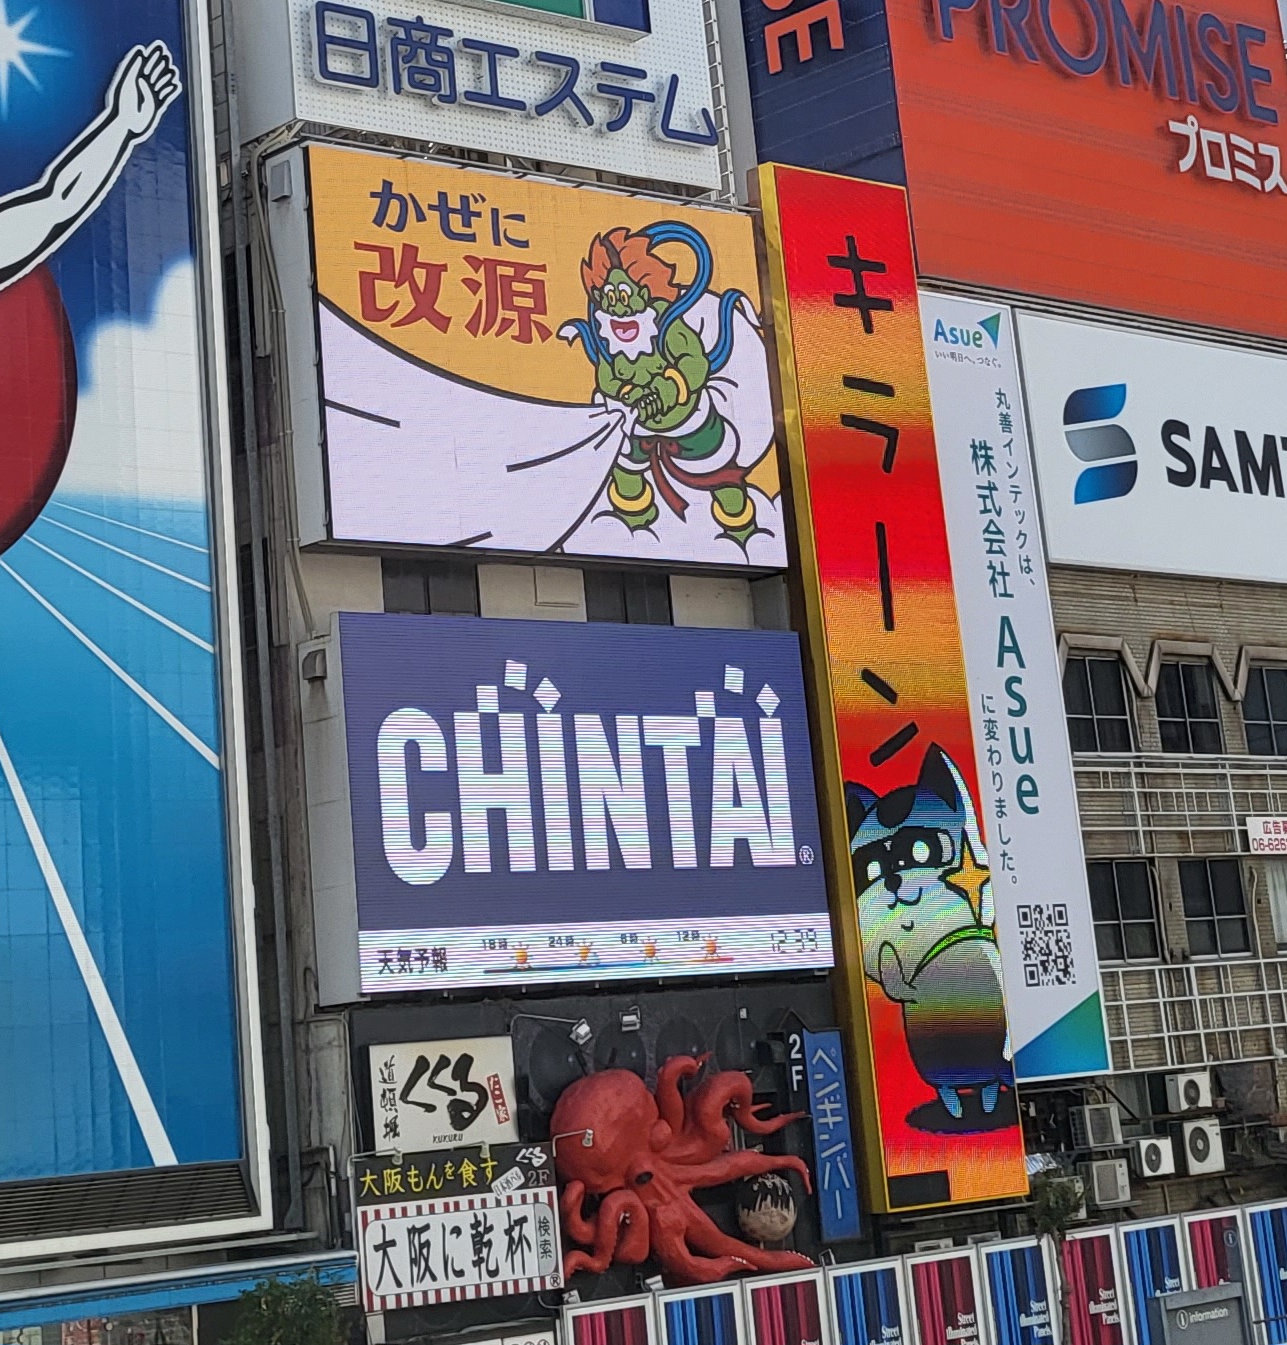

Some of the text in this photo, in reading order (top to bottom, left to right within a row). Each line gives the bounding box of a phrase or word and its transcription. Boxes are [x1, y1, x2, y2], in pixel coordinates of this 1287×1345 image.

[313, 0, 721, 146] 日商エステム
[369, 178, 532, 249] かぜに
[353, 240, 554, 346] 改源
[933, 318, 984, 349] Asue
[826, 234, 920, 767] キラーン
[994, 386, 1036, 587] 丸善インテックは、
[969, 437, 1041, 816] 株式会社 Asue
[977, 693, 1018, 885] に変わりました。
[377, 946, 449, 975] 天気予報
[378, 1055, 401, 1142] 道頓堀
[399, 1053, 490, 1132] くくる
[432, 1132, 464, 1144] KUKURU
[515, 1147, 548, 1167] くくる
[812, 1046, 854, 1221] ペンギンバー
[359, 1157, 499, 1198] 大阪もんを食す
[527, 1168, 551, 1187] 2F
[373, 1209, 533, 1292] 大阪に乾杯
[537, 1216, 553, 1260] 検索
[881, 1325, 901, 1340] Street
[956, 1312, 976, 1327] Street
[1029, 1300, 1048, 1314] Street
[1189, 1306, 1229, 1325] information
